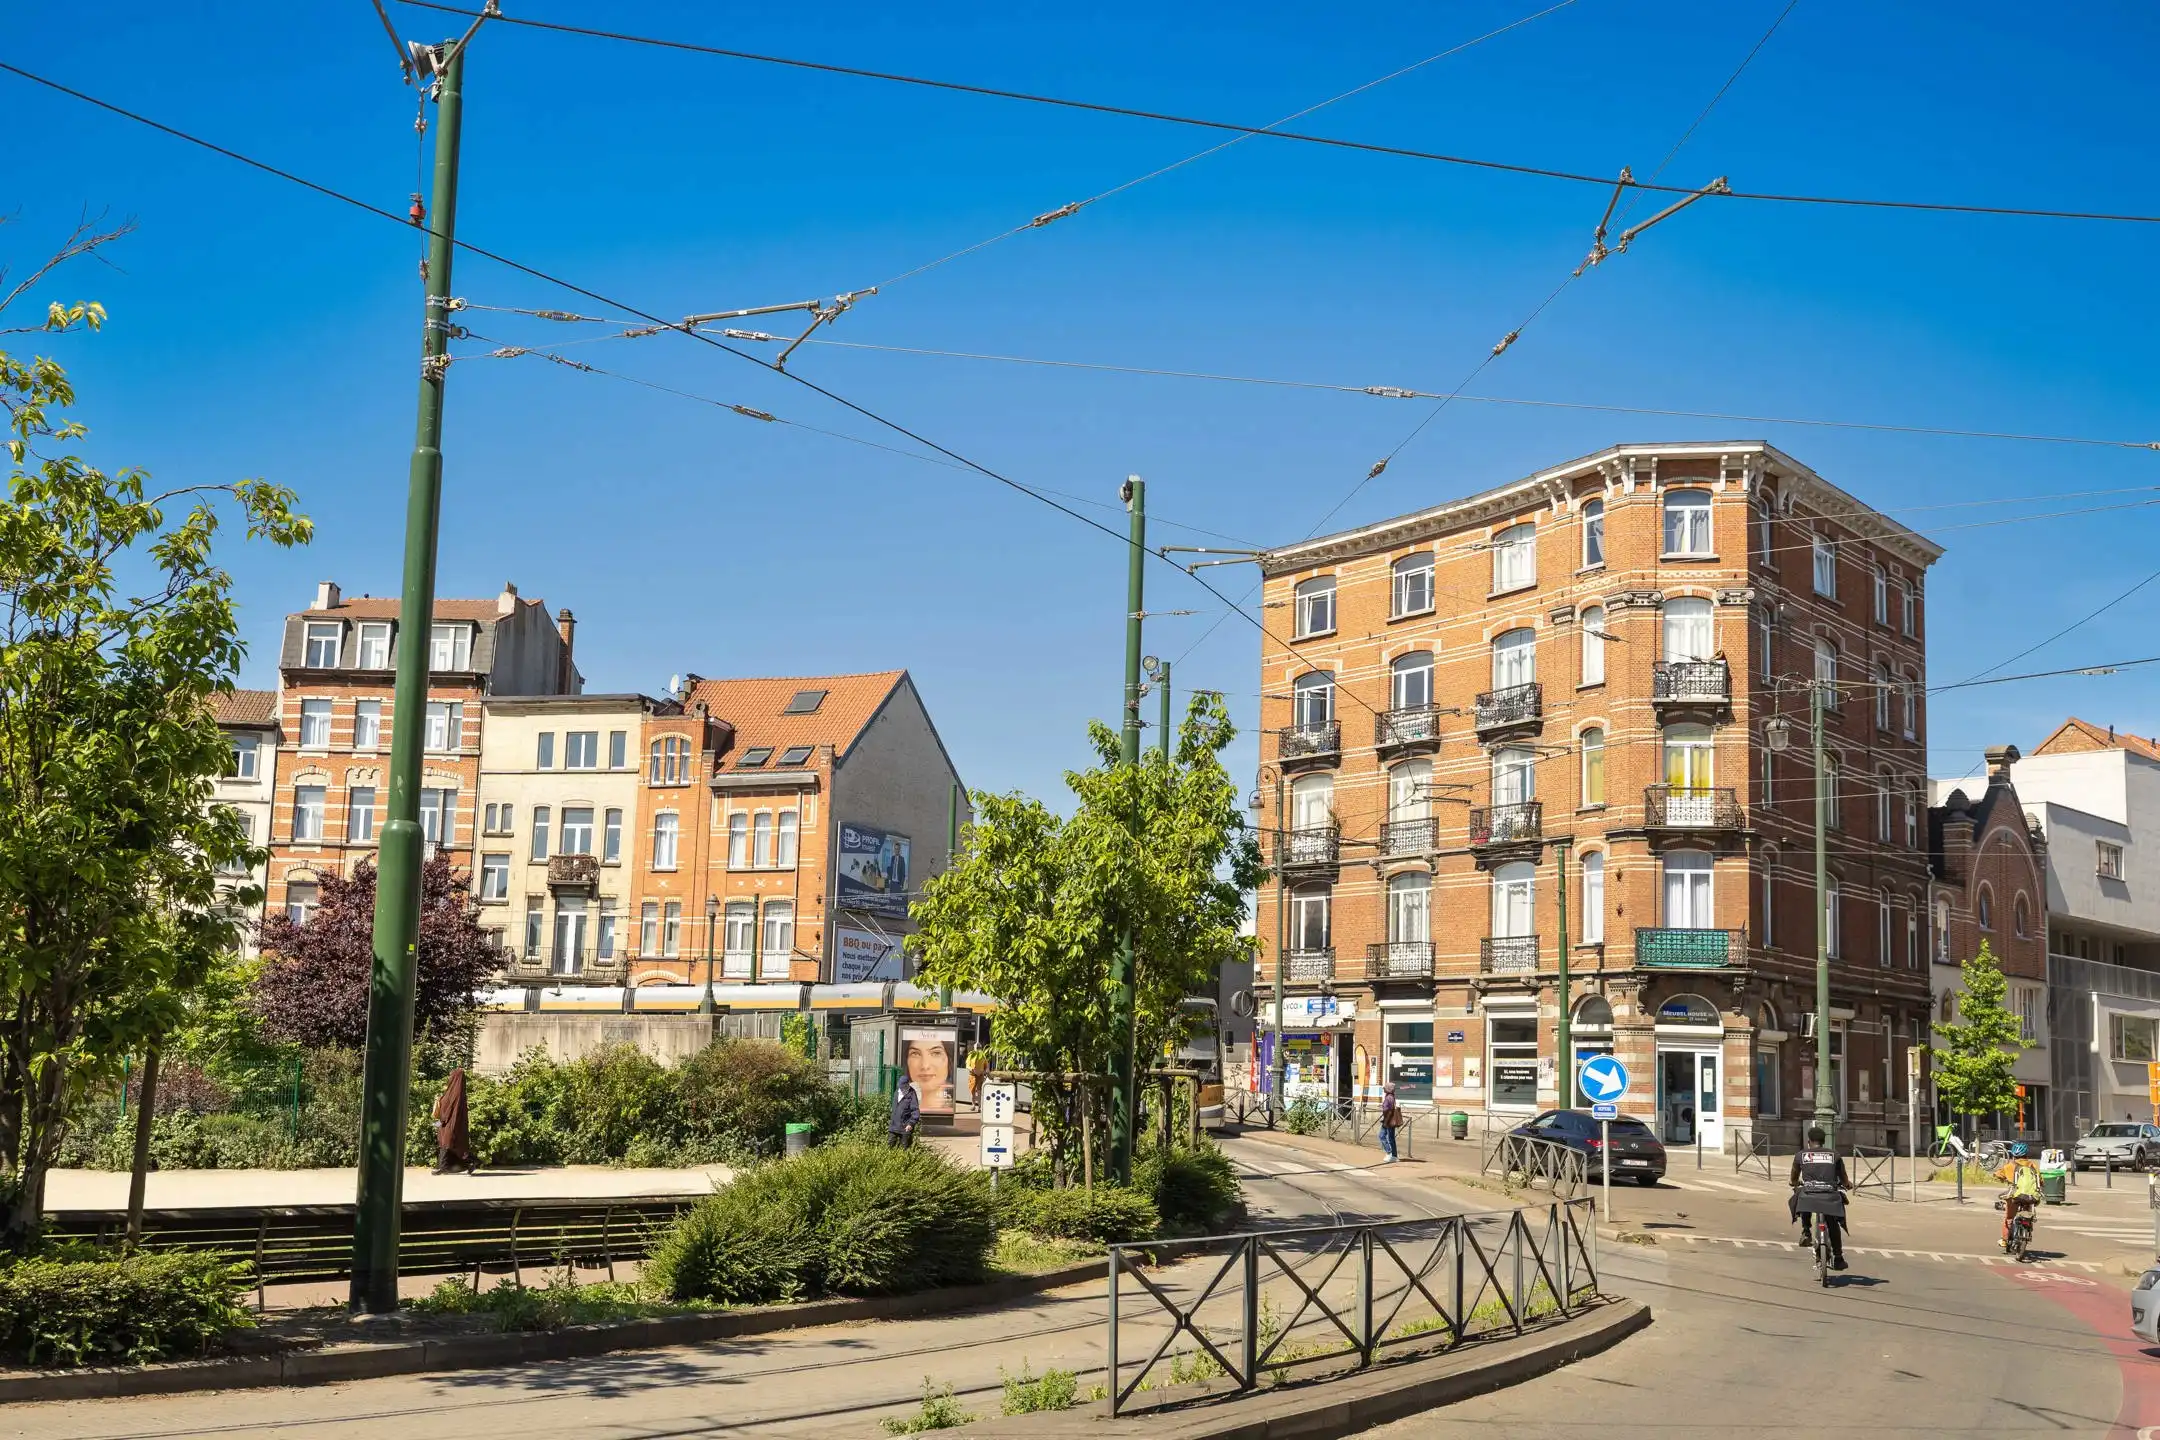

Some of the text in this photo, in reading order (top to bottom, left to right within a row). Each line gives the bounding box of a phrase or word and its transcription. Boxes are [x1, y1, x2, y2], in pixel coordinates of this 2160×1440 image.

[843, 937, 860, 950] BBQ
[841, 961, 861, 972] chaque
[995, 1129, 1000, 1137] 1
[994, 1137, 1001, 1147] 2
[993, 1154, 1000, 1163] 3
